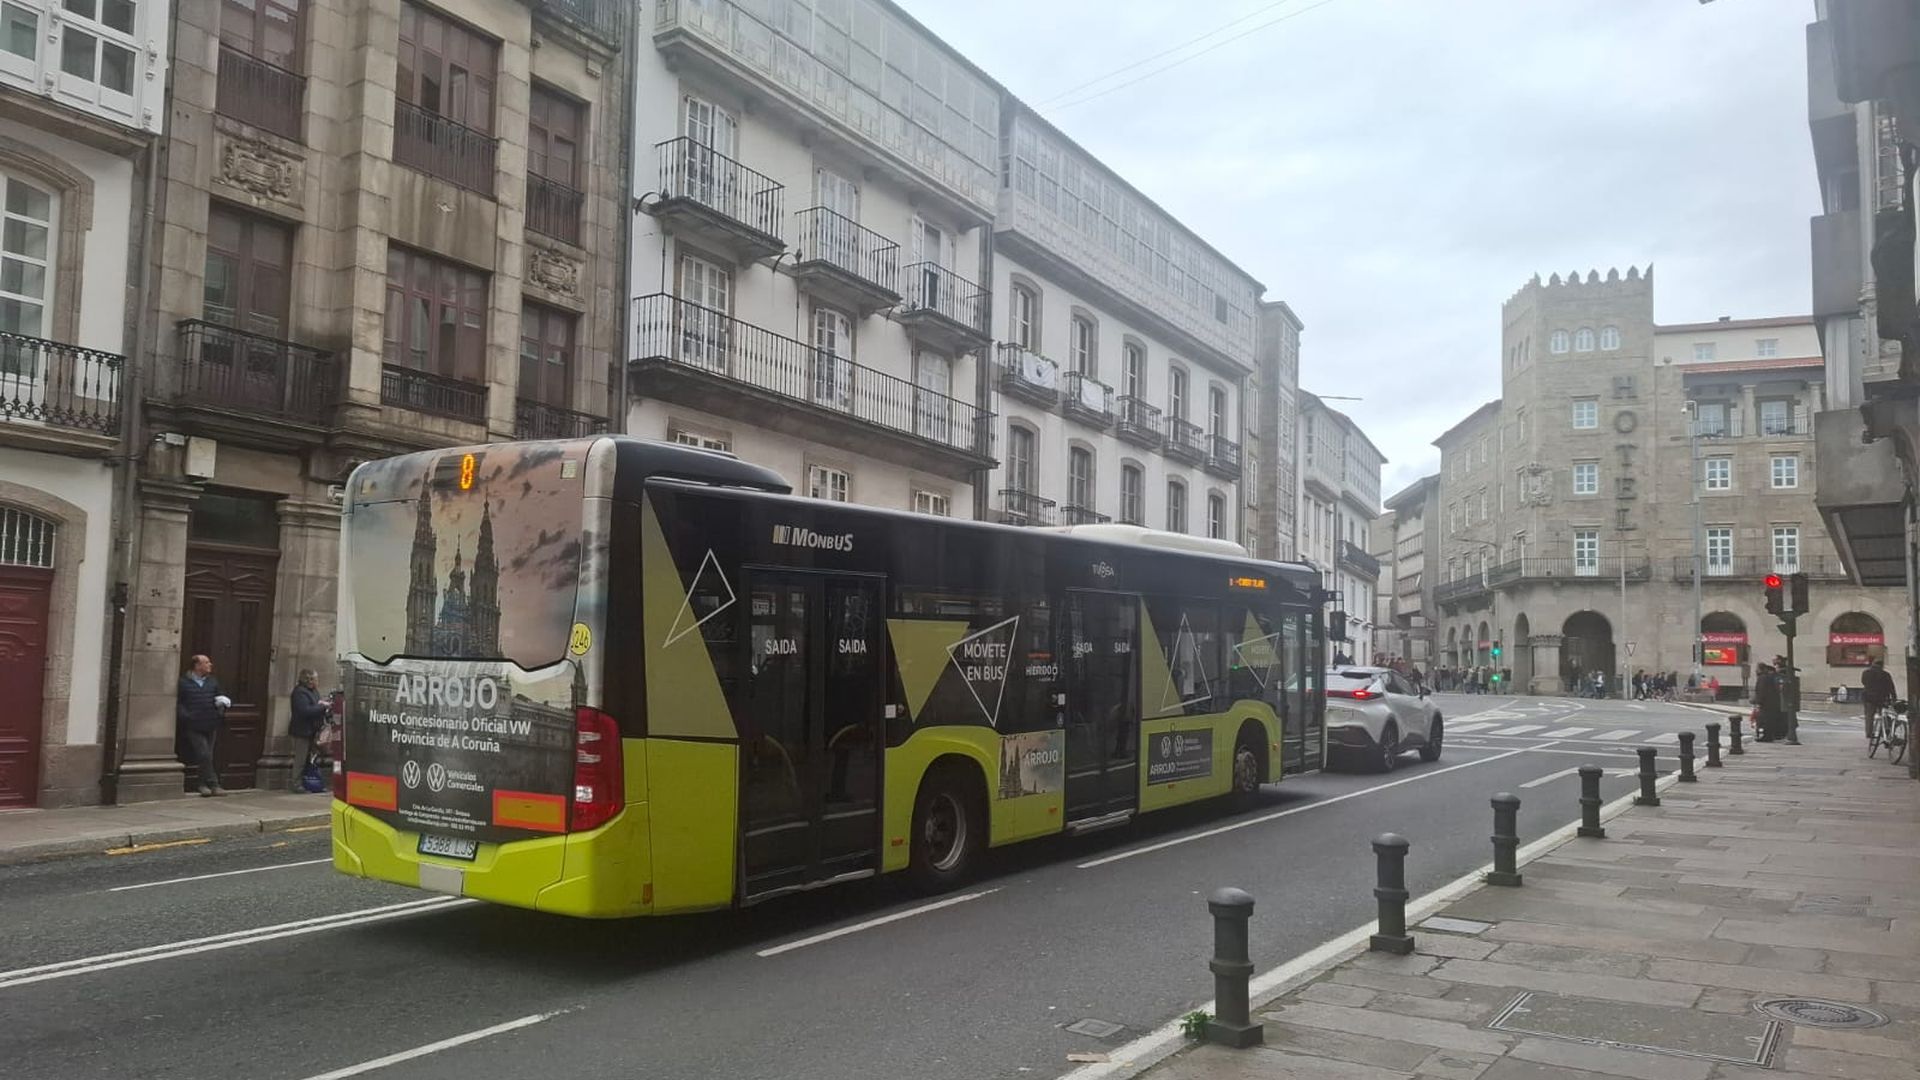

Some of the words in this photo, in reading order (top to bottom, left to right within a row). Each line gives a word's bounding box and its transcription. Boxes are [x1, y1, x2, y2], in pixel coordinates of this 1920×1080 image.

[1612, 375, 1639, 532] HOTEL
[461, 453, 474, 489] 8
[765, 639, 797, 654] SAIDA
[839, 639, 867, 653] SAIDA
[964, 639, 1006, 658] MÓVETE
[967, 665, 982, 681] EN
[983, 665, 1004, 681] BUS
[395, 673, 498, 710] ARROJO
[369, 709, 398, 725] Nuevo
[400, 712, 469, 731] Concesionario
[471, 717, 507, 734] Oficial
[510, 720, 532, 735] VW
[391, 729, 435, 747] Provincia
[437, 734, 450, 748] de
[451, 736, 460, 748] A
[461, 736, 500, 752] Coruña
[1023, 749, 1058, 767] ARROJO
